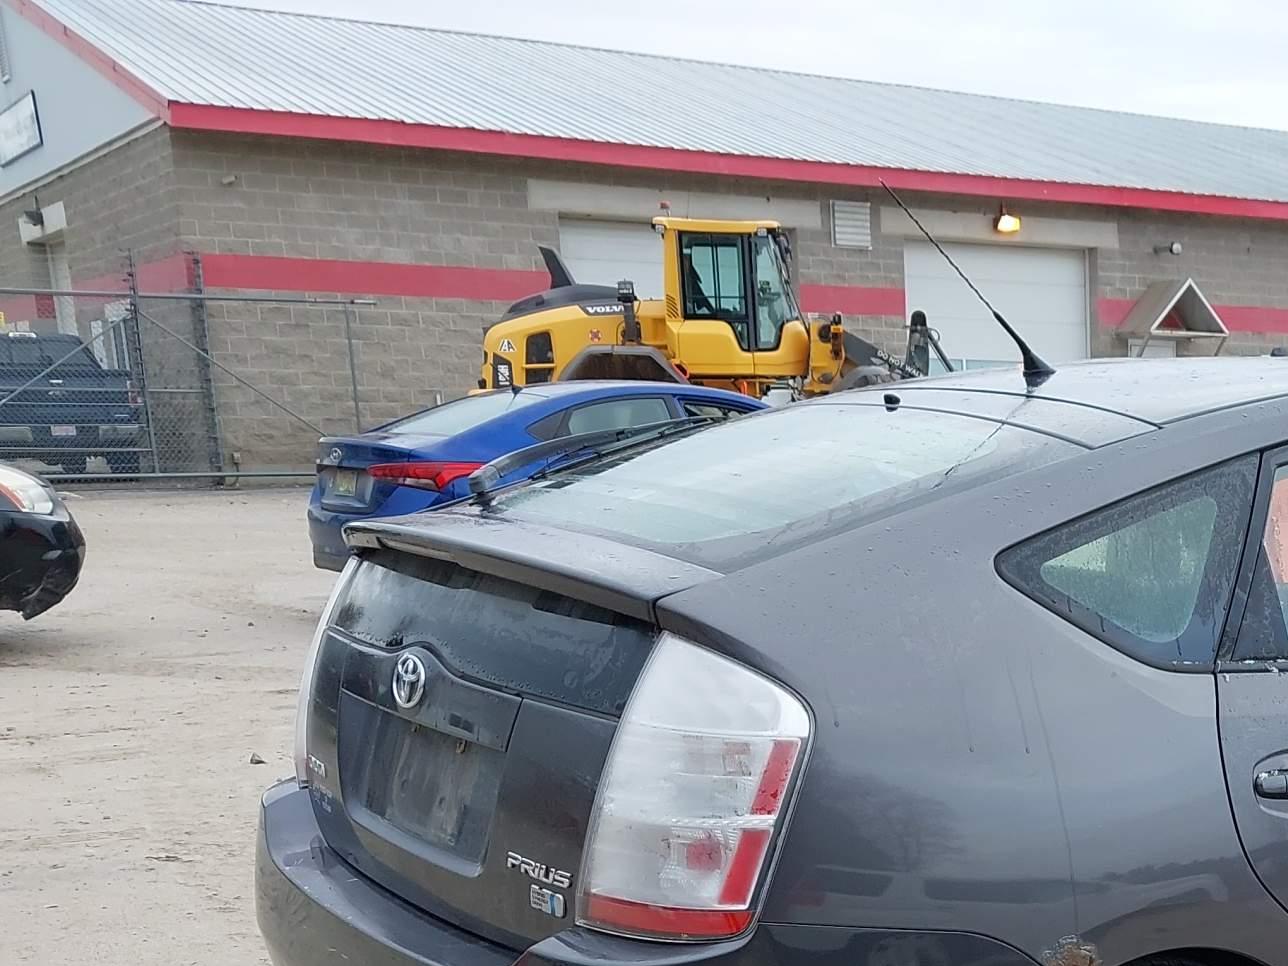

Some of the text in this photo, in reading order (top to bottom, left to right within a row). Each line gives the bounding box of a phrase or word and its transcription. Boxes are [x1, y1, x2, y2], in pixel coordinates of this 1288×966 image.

[586, 305, 624, 314] VOLV
[876, 350, 889, 361] DO
[888, 356, 905, 368] NOT
[507, 851, 572, 888] PRIUS
